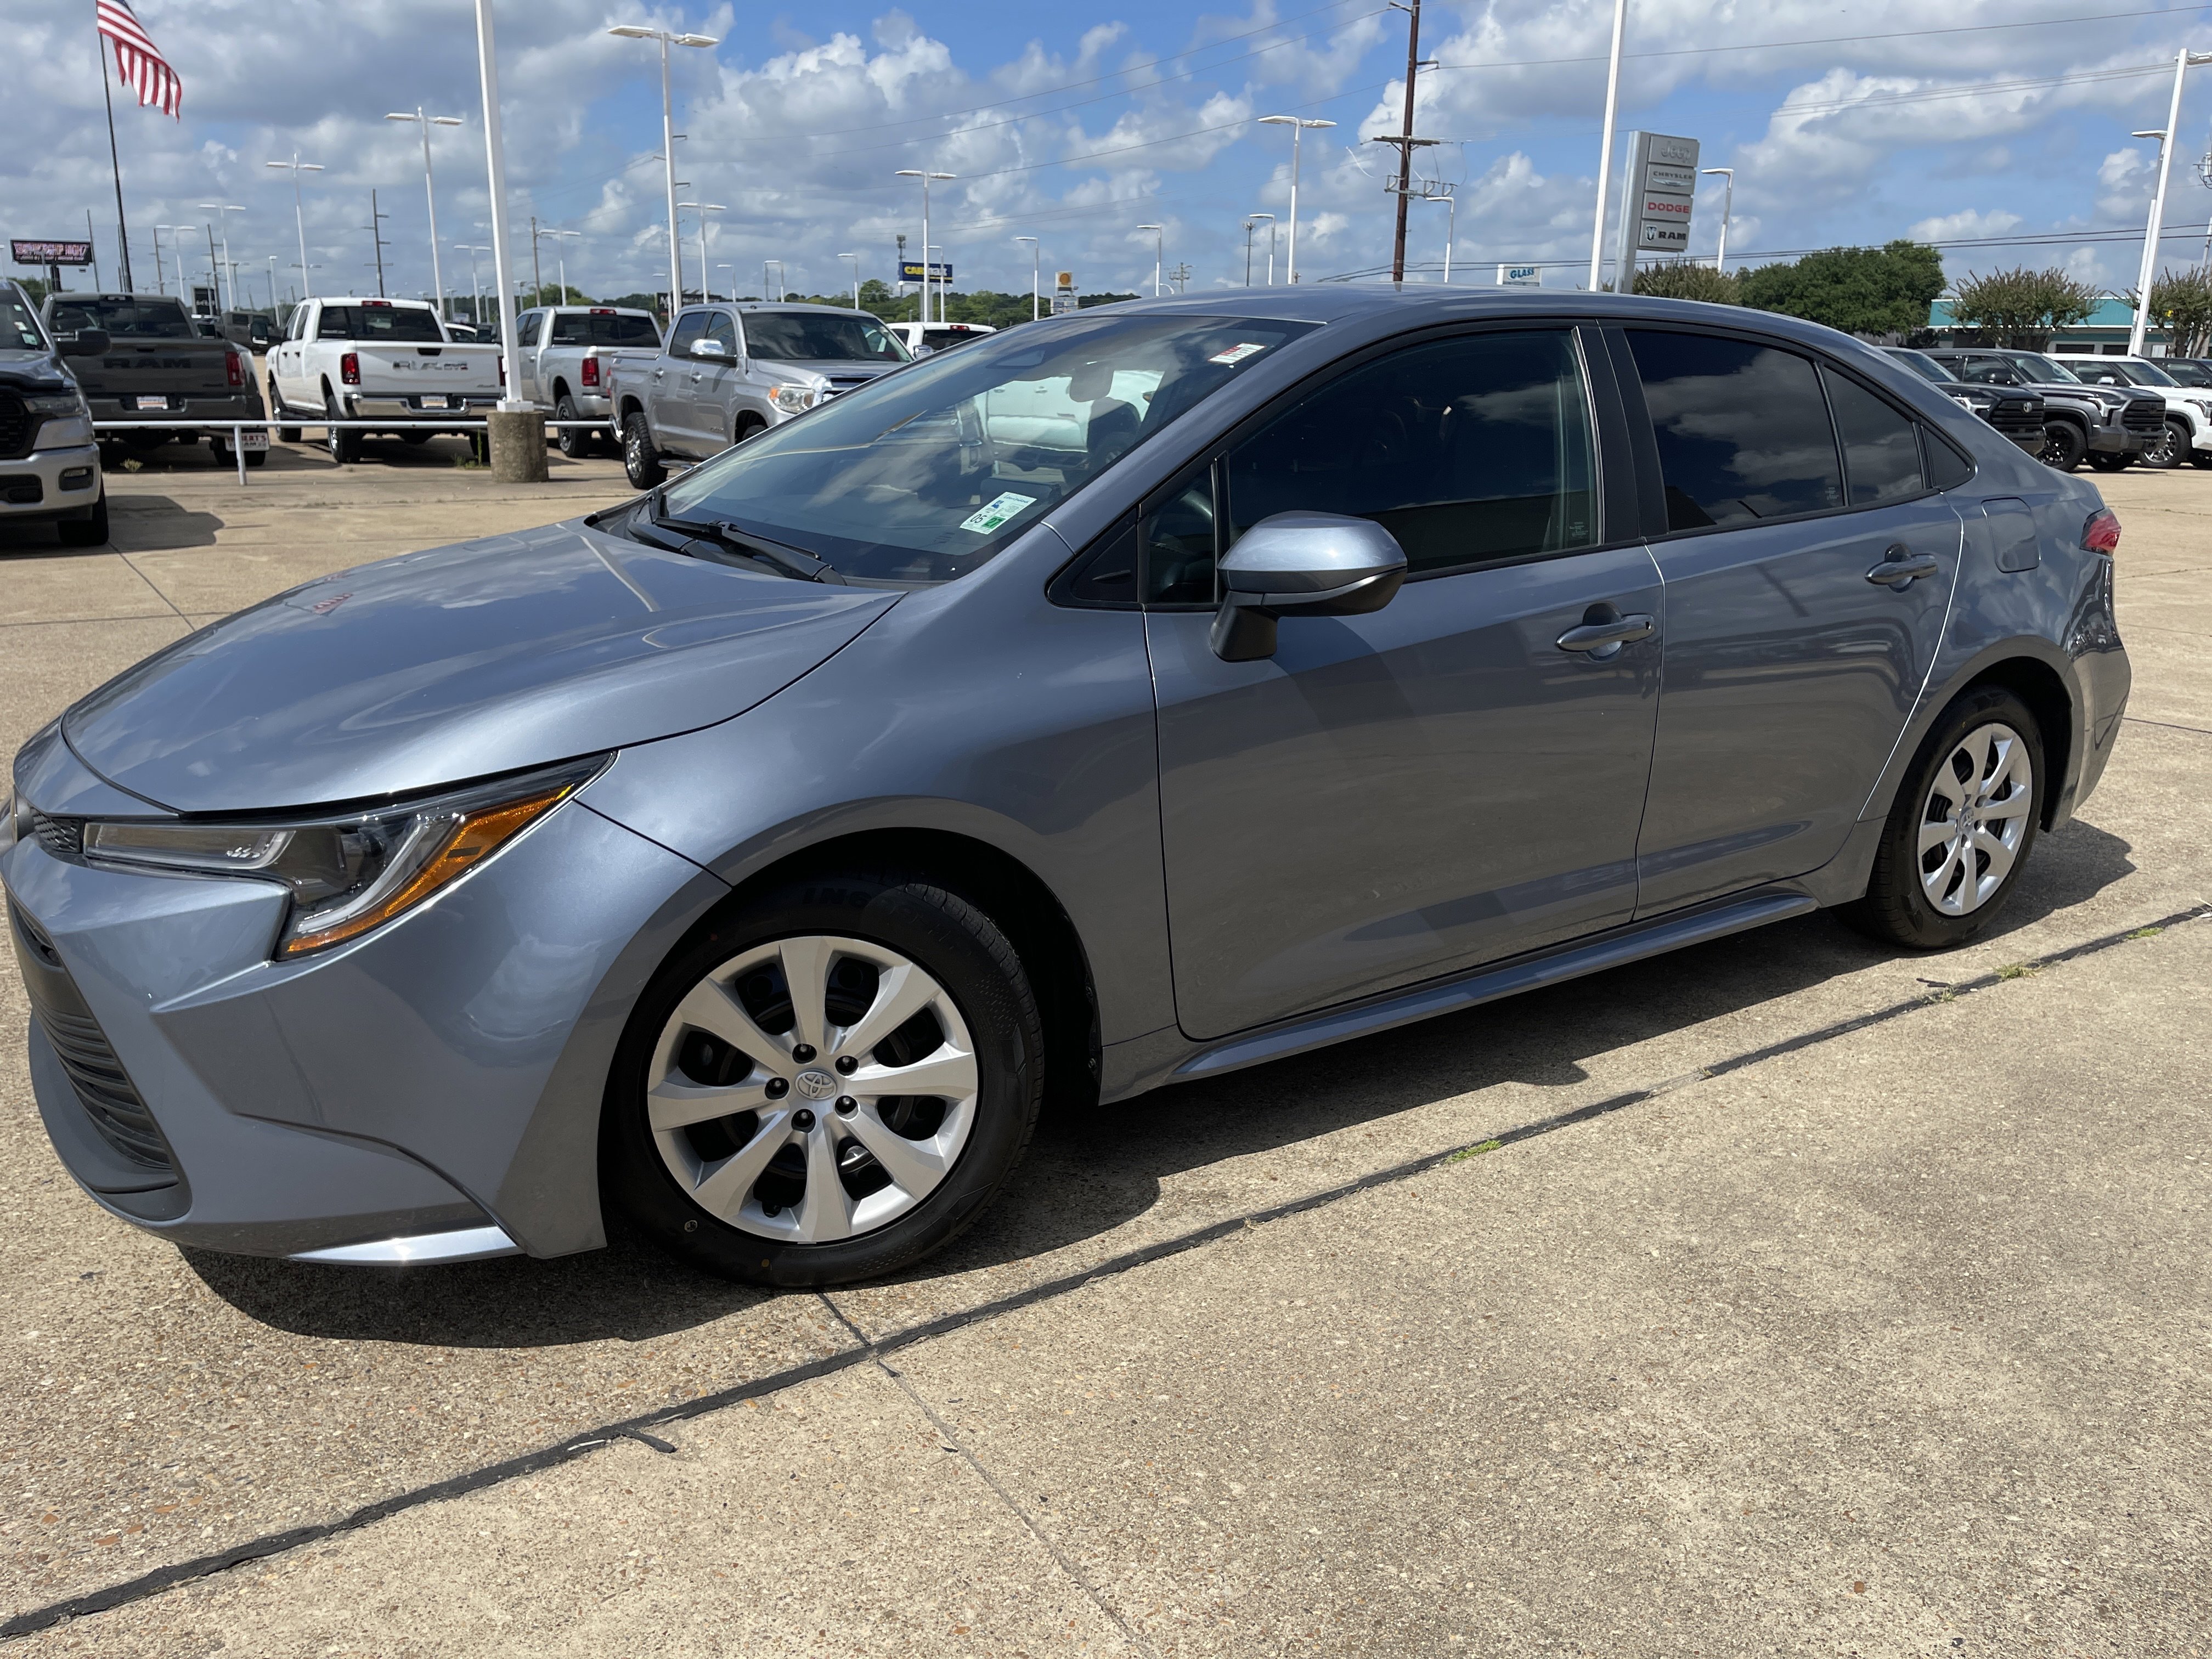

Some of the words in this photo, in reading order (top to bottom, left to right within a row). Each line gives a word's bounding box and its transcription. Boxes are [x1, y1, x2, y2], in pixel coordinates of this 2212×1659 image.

[1661, 140, 1690, 163] Jeep
[1653, 171, 1693, 179] CHRYSLER
[1648, 202, 1690, 213] DODGE
[1658, 232, 1686, 241] RAM
[103, 358, 191, 369] RAM
[970, 514, 987, 523] 05
[985, 517, 1003, 527] 27
